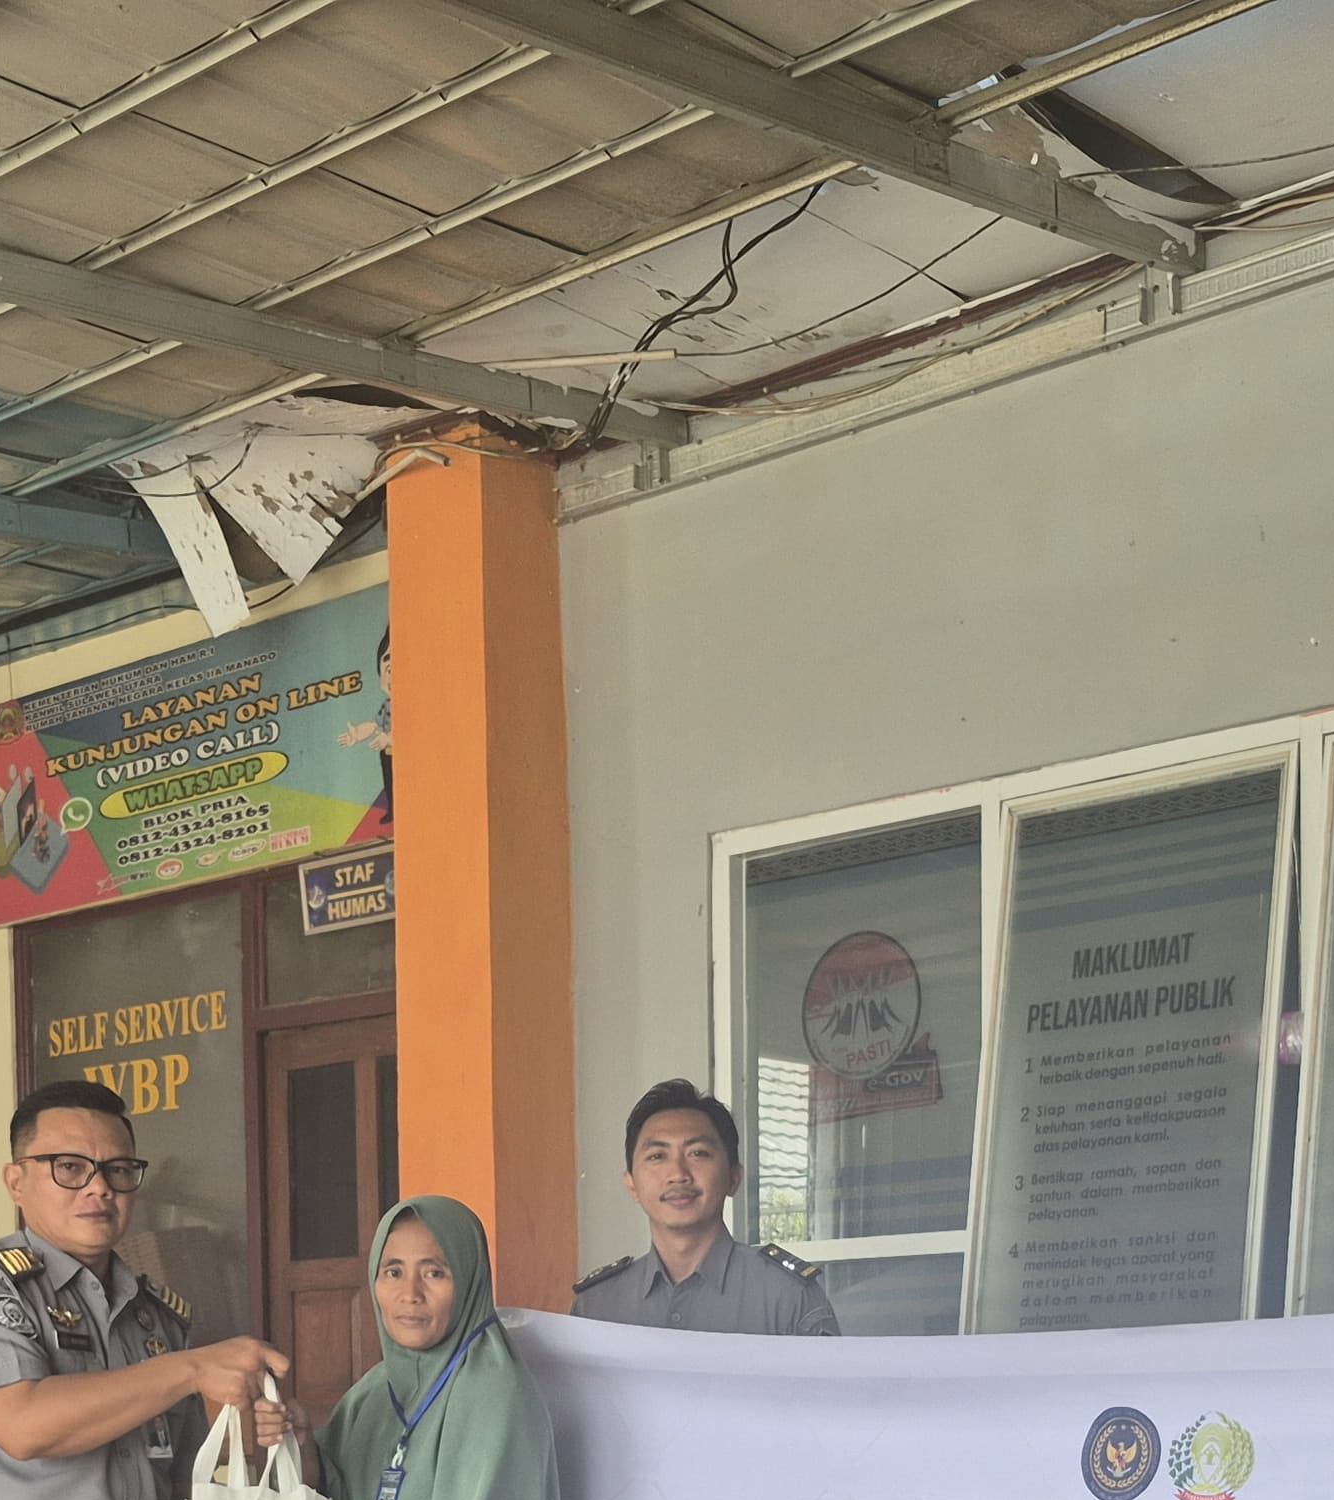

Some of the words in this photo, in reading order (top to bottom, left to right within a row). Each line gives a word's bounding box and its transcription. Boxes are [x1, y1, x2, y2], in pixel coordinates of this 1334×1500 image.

[25, 684, 97, 711] KEMENTERIAN
[101, 669, 142, 687] HUKUM
[145, 661, 168, 674] DAN
[170, 653, 197, 668] HAM
[25, 704, 64, 720] KANWIL
[68, 687, 122, 708] SULAWESI
[125, 675, 161, 692] UTARA
[26, 716, 63, 732] RUMAH
[67, 701, 116, 721] TAHANAN
[119, 685, 164, 706] NEGARA
[167, 673, 204, 691] KELAS
[226, 652, 276, 672] MANADO
[121, 672, 262, 730] LAYANAN
[47, 708, 227, 778] KUNJUNGAN
[235, 696, 281, 725] ON
[287, 671, 363, 711] LINE
[96, 748, 189, 788] (VIDEO
[195, 721, 280, 760] CALL)
[123, 757, 264, 813] WHATSAPP
[117, 803, 271, 849] 0812-4324-8165
[143, 806, 195, 829] BLOK
[200, 794, 249, 816] PRIA
[117, 820, 270, 866] 0812-4324-8201
[335, 862, 374, 888] STAF
[327, 891, 386, 921] HUMAS
[1071, 932, 1195, 979] MAKLUMAT
[1027, 989, 1149, 1034] PELAYANAN
[1154, 975, 1236, 1017] PUBLIK
[49, 1012, 108, 1057] SELF
[114, 990, 227, 1047] SERVICE
[846, 1039, 892, 1068] PASTI
[1040, 1046, 1135, 1067] Memberikan
[1145, 1034, 1231, 1056] pelayanan
[867, 1070, 926, 1092] e-Gov
[1039, 1067, 1082, 1085] terbaik
[1085, 1065, 1135, 1081] dengan
[1020, 1106, 1030, 1122] 2
[1036, 1103, 1066, 1119] Siap
[1075, 1090, 1167, 1114] menanggapi
[1177, 1085, 1227, 1103] segala
[1034, 1118, 1085, 1136] keluhan
[1126, 1106, 1226, 1126] ketidakpuasan
[1062, 1134, 1132, 1153] pelayanan
[1014, 1175, 1024, 1191] 3
[1031, 1169, 1084, 1187] Bersikap
[1145, 1161, 1187, 1178] sopan
[1195, 1157, 1222, 1171] dan
[1029, 1190, 1072, 1204] santun
[1080, 1185, 1123, 1200] dalam
[1131, 1177, 1221, 1196] memberikan
[1025, 1237, 1117, 1254] Memberikan
[1186, 1229, 1216, 1243] dan
